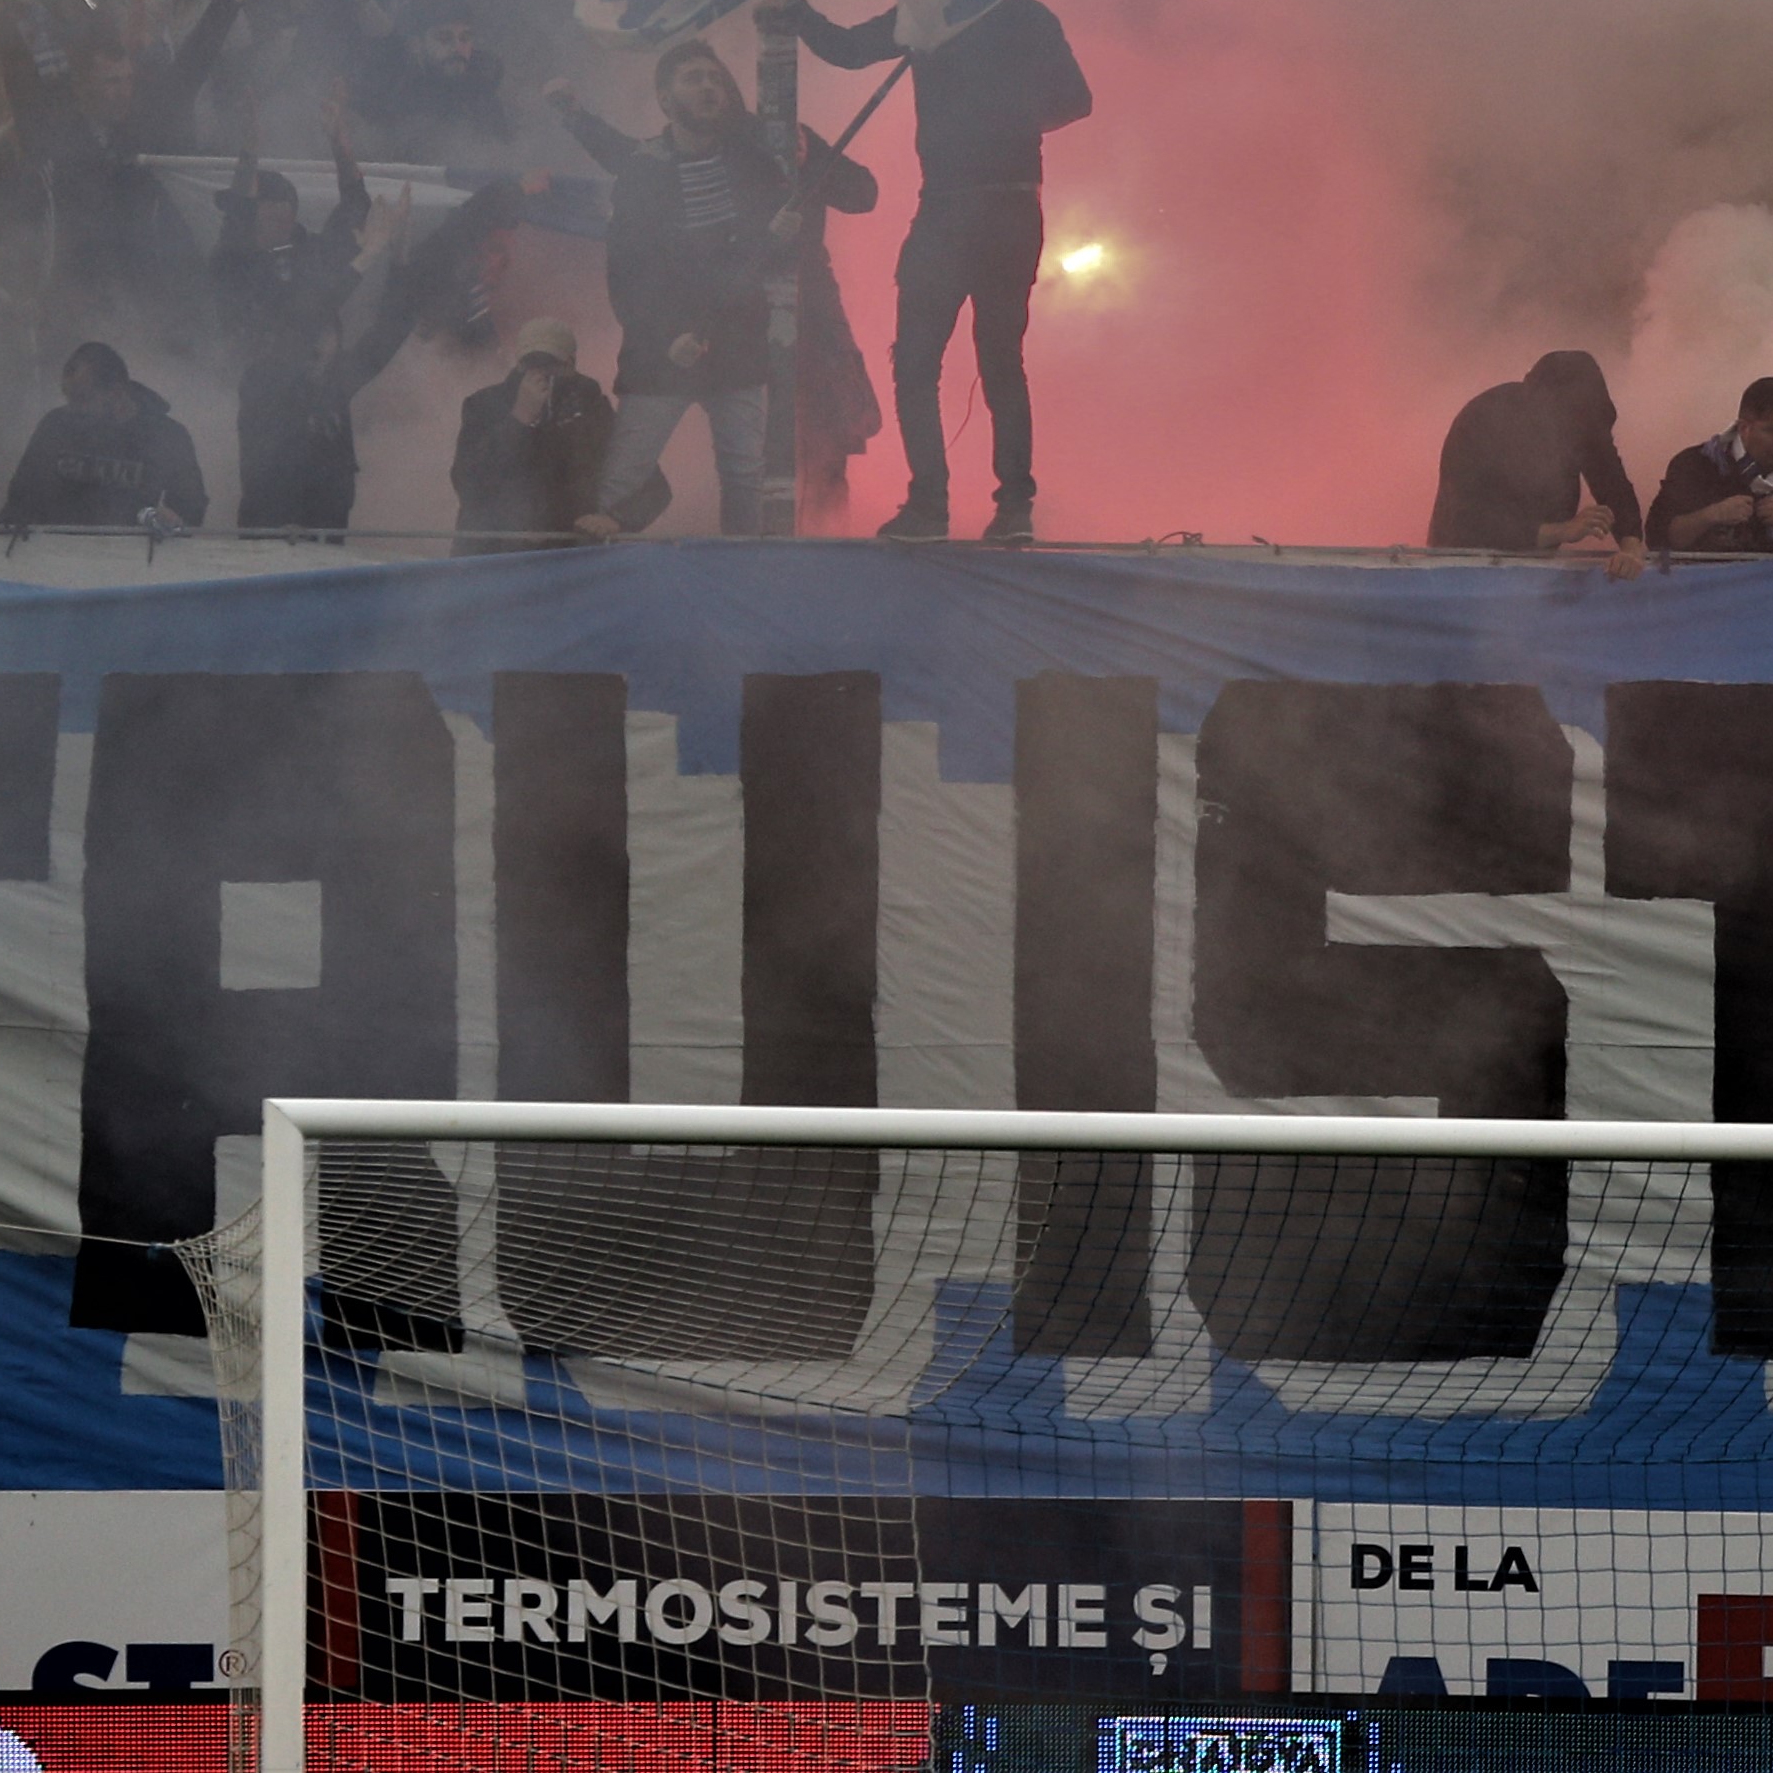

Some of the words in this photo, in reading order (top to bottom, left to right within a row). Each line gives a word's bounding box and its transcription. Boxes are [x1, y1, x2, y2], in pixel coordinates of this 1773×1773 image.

[1351, 1544, 1435, 1591] DE
[1454, 1546, 1540, 1593] LA
[386, 1578, 1108, 1649] TERMOSISTEME
